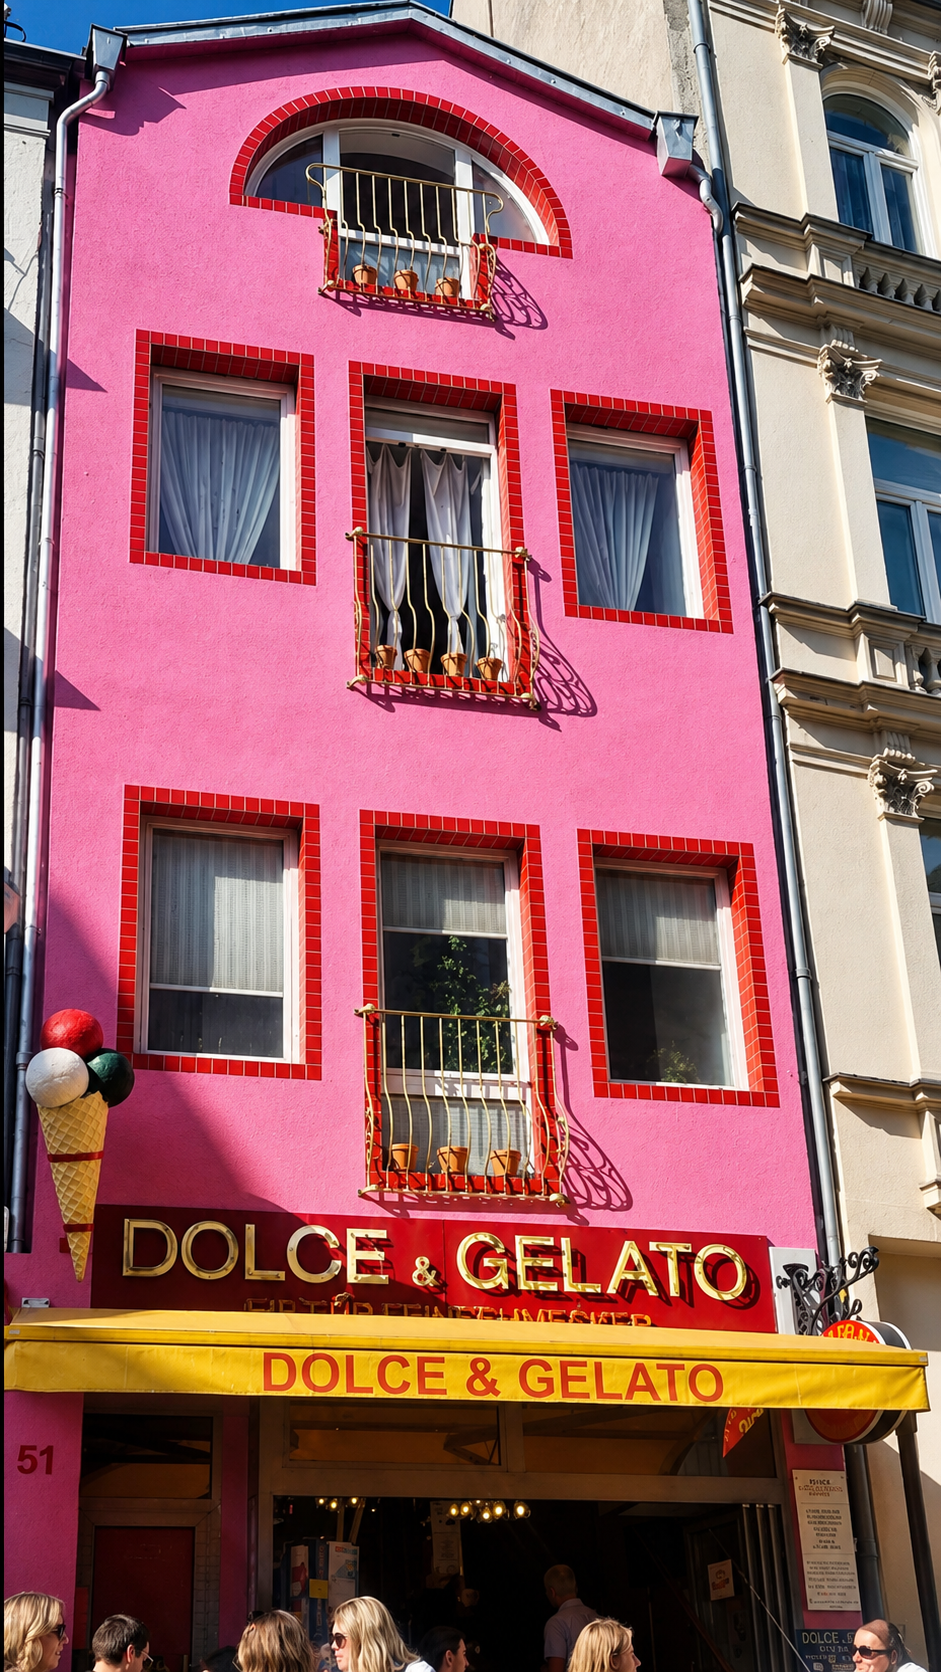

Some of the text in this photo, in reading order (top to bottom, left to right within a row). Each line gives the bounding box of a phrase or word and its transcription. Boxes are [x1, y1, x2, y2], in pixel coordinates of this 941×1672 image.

[122, 1218, 748, 1301] DOLCE & GELATO
[263, 1352, 724, 1403] DOLCE & GELATO
[16, 1444, 54, 1476] 51
[801, 1631, 840, 1645] DOLCE
